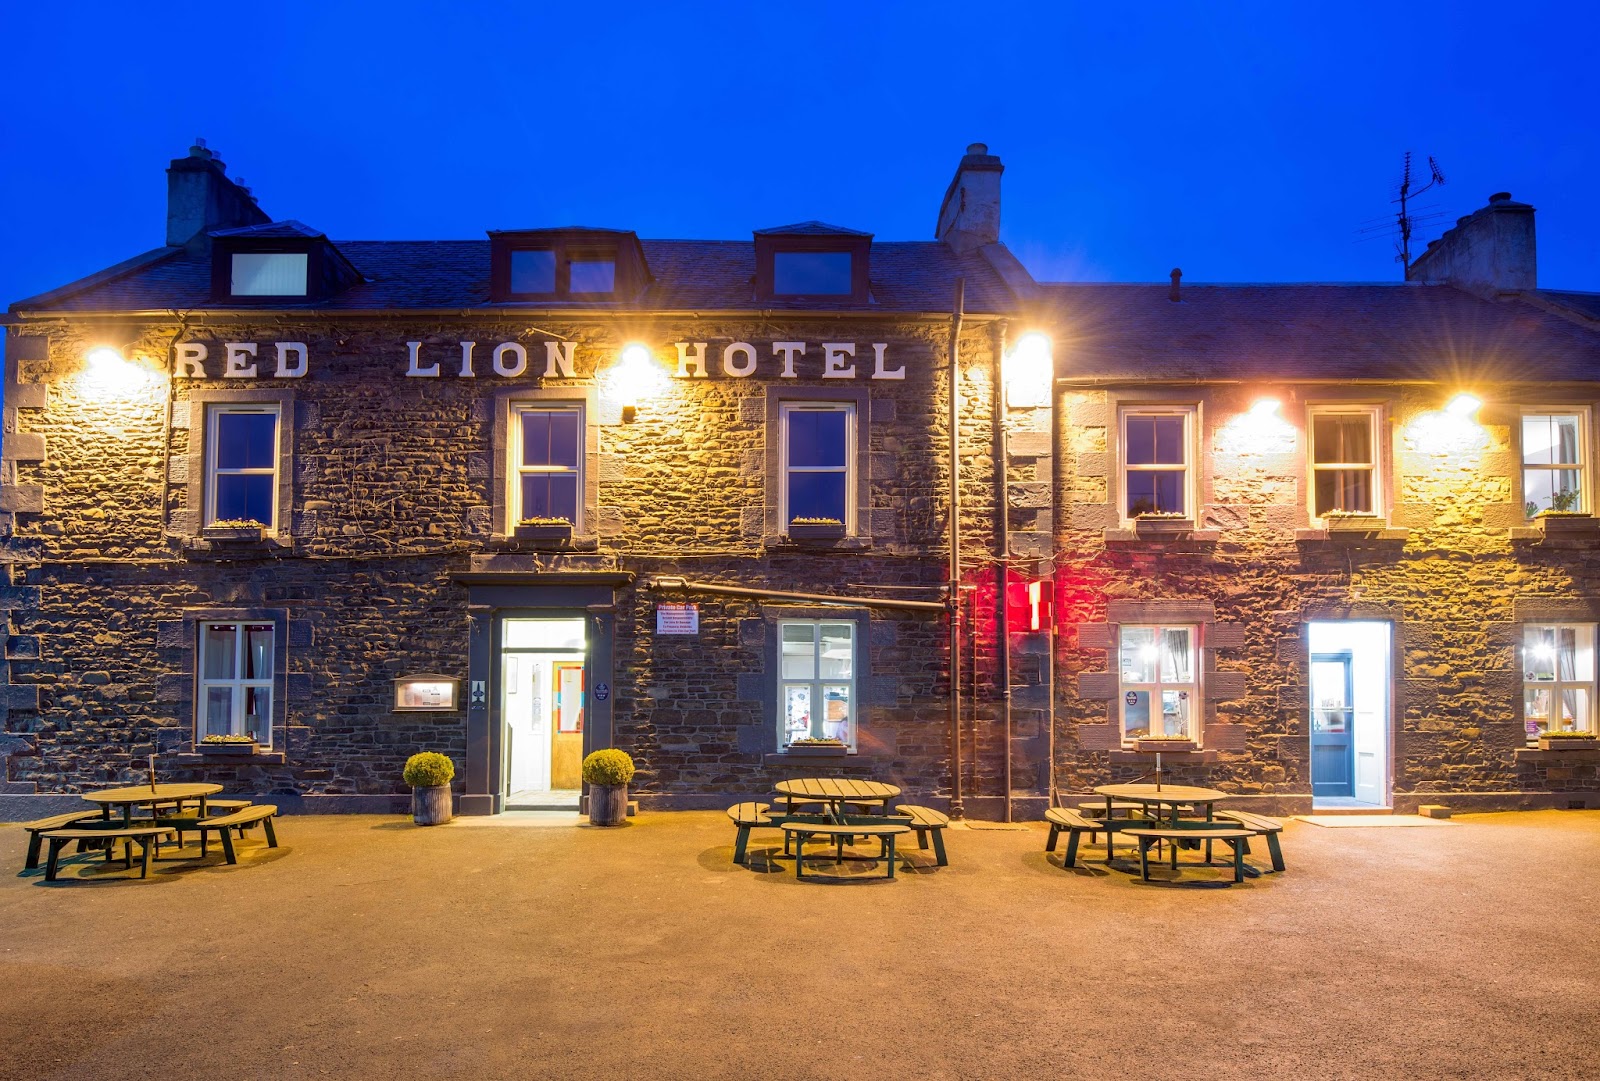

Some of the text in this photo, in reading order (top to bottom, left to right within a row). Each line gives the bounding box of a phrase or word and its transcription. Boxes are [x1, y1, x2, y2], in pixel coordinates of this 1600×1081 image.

[173, 341, 906, 379] RED LION HOTEL
